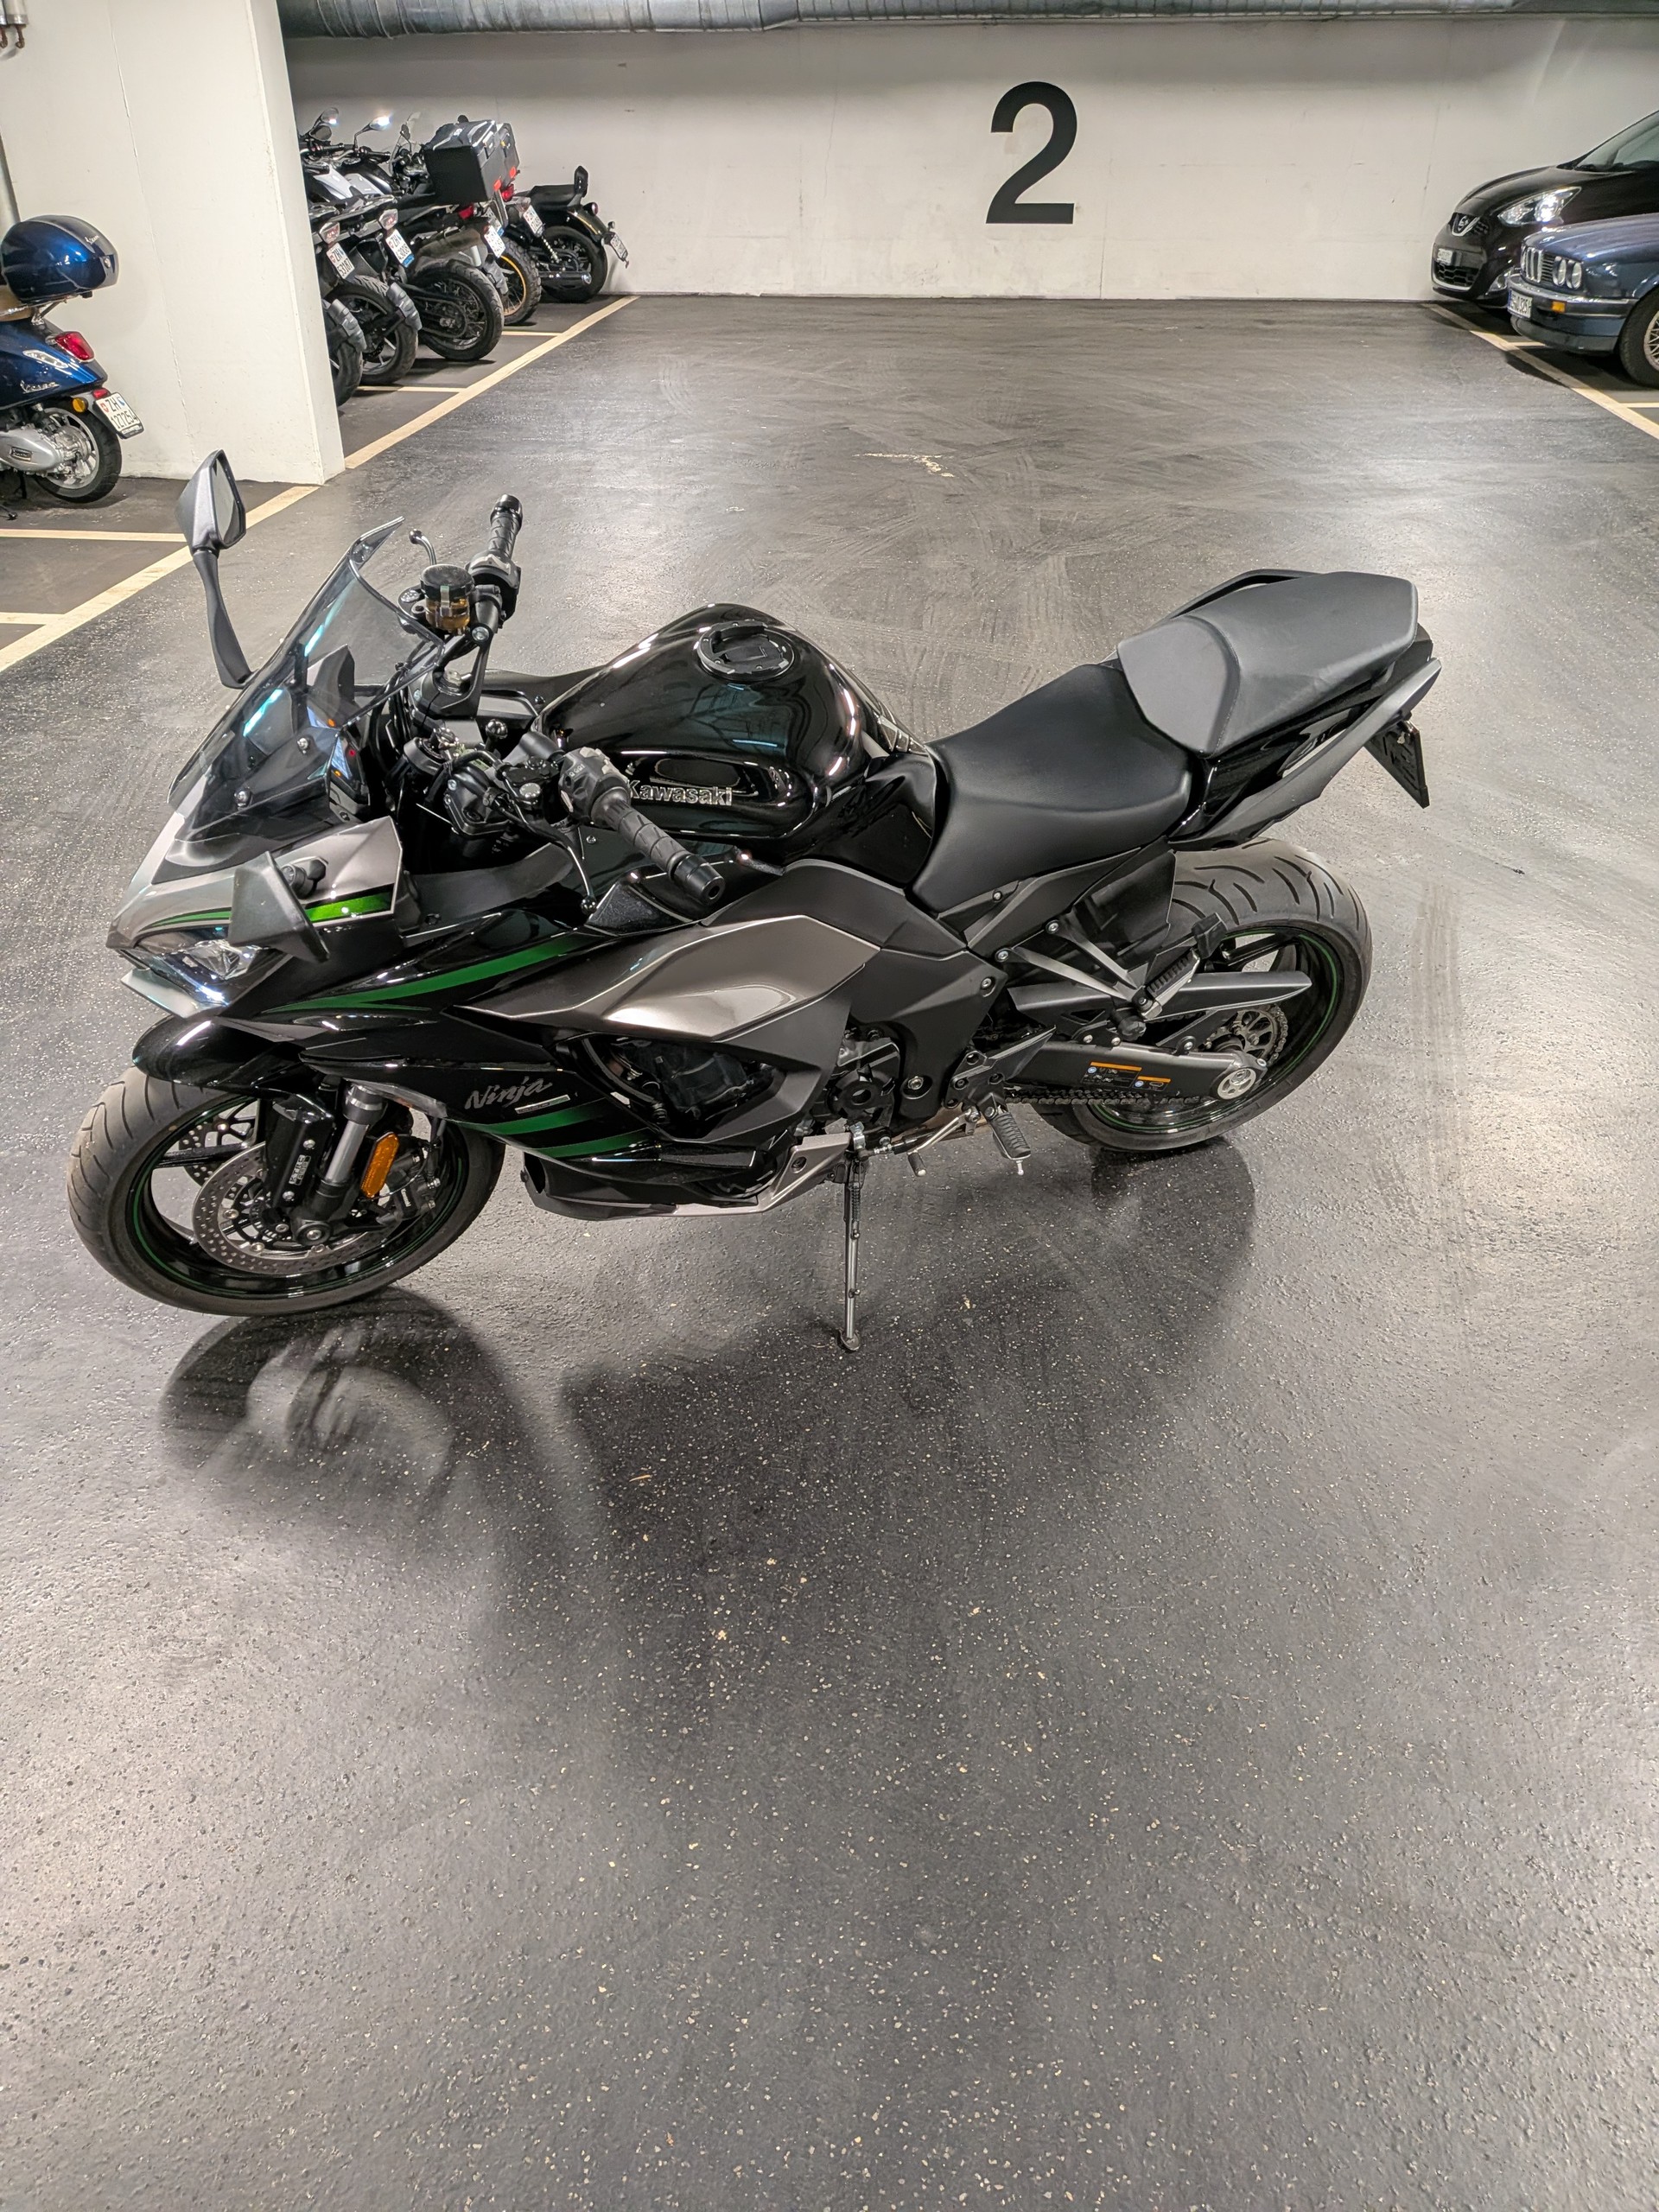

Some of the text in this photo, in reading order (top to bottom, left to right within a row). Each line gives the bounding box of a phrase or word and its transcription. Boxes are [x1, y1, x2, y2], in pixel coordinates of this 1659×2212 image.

[986, 81, 1077, 224] 2
[332, 248, 343, 262] ZH
[105, 397, 122, 412] ZH
[110, 409, 138, 429] 127254
[627, 779, 733, 806] Kawasaki
[464, 1076, 553, 1109] Ninja
